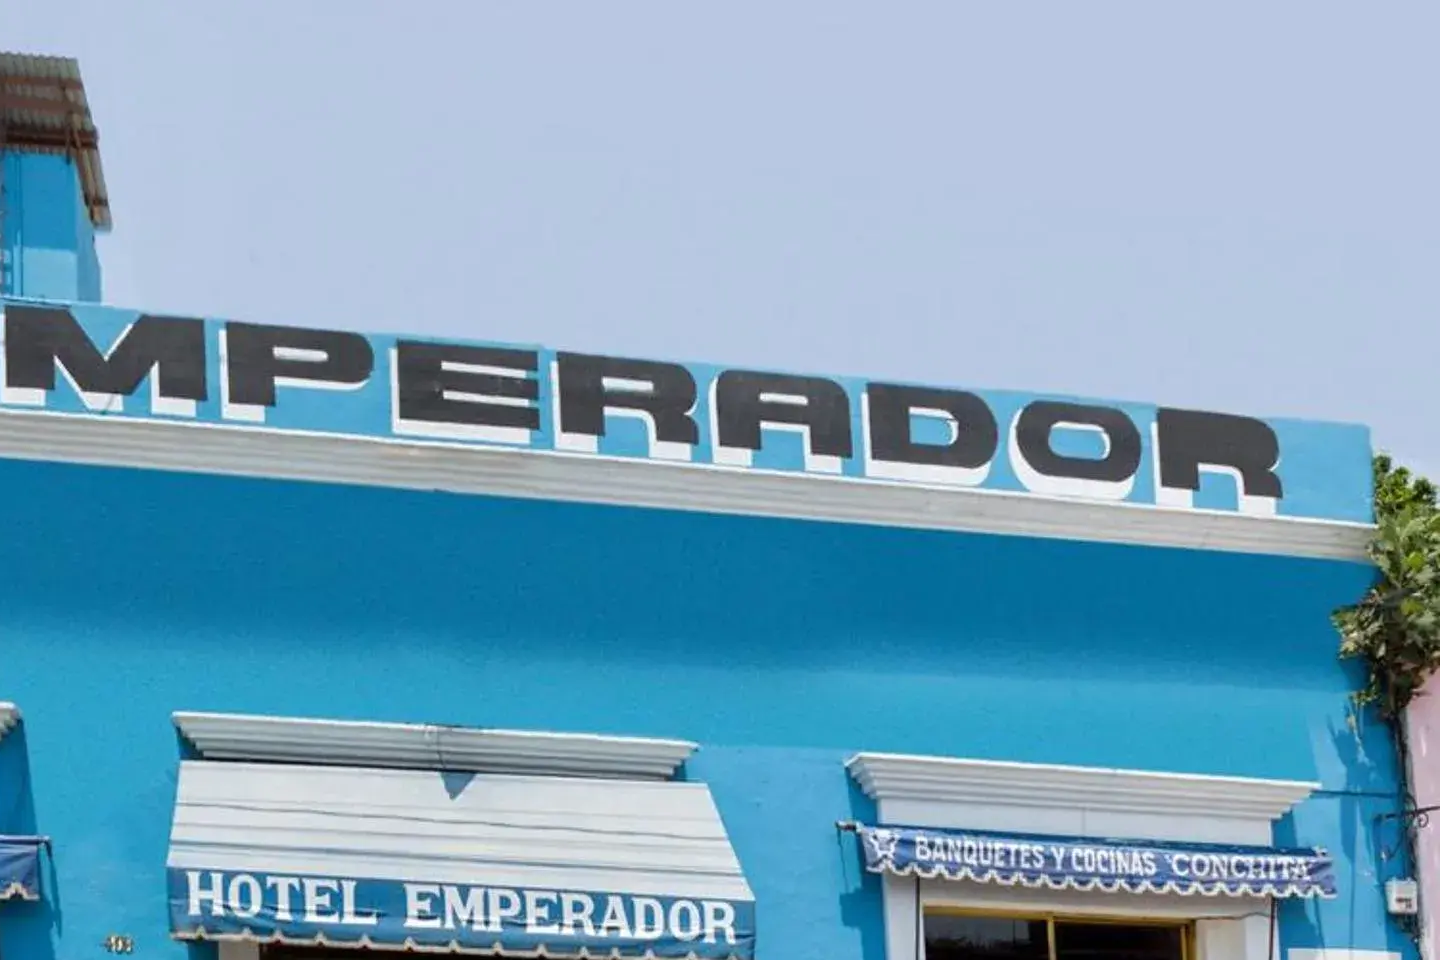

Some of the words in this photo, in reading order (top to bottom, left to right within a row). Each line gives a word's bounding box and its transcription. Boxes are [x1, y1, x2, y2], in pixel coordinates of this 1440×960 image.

[914, 835, 1045, 870] BANQUETES
[1050, 847, 1066, 871] Y
[1071, 848, 1156, 877] COCINAS
[186, 870, 377, 926] HOTEL
[403, 882, 736, 945] EMPERADOR
